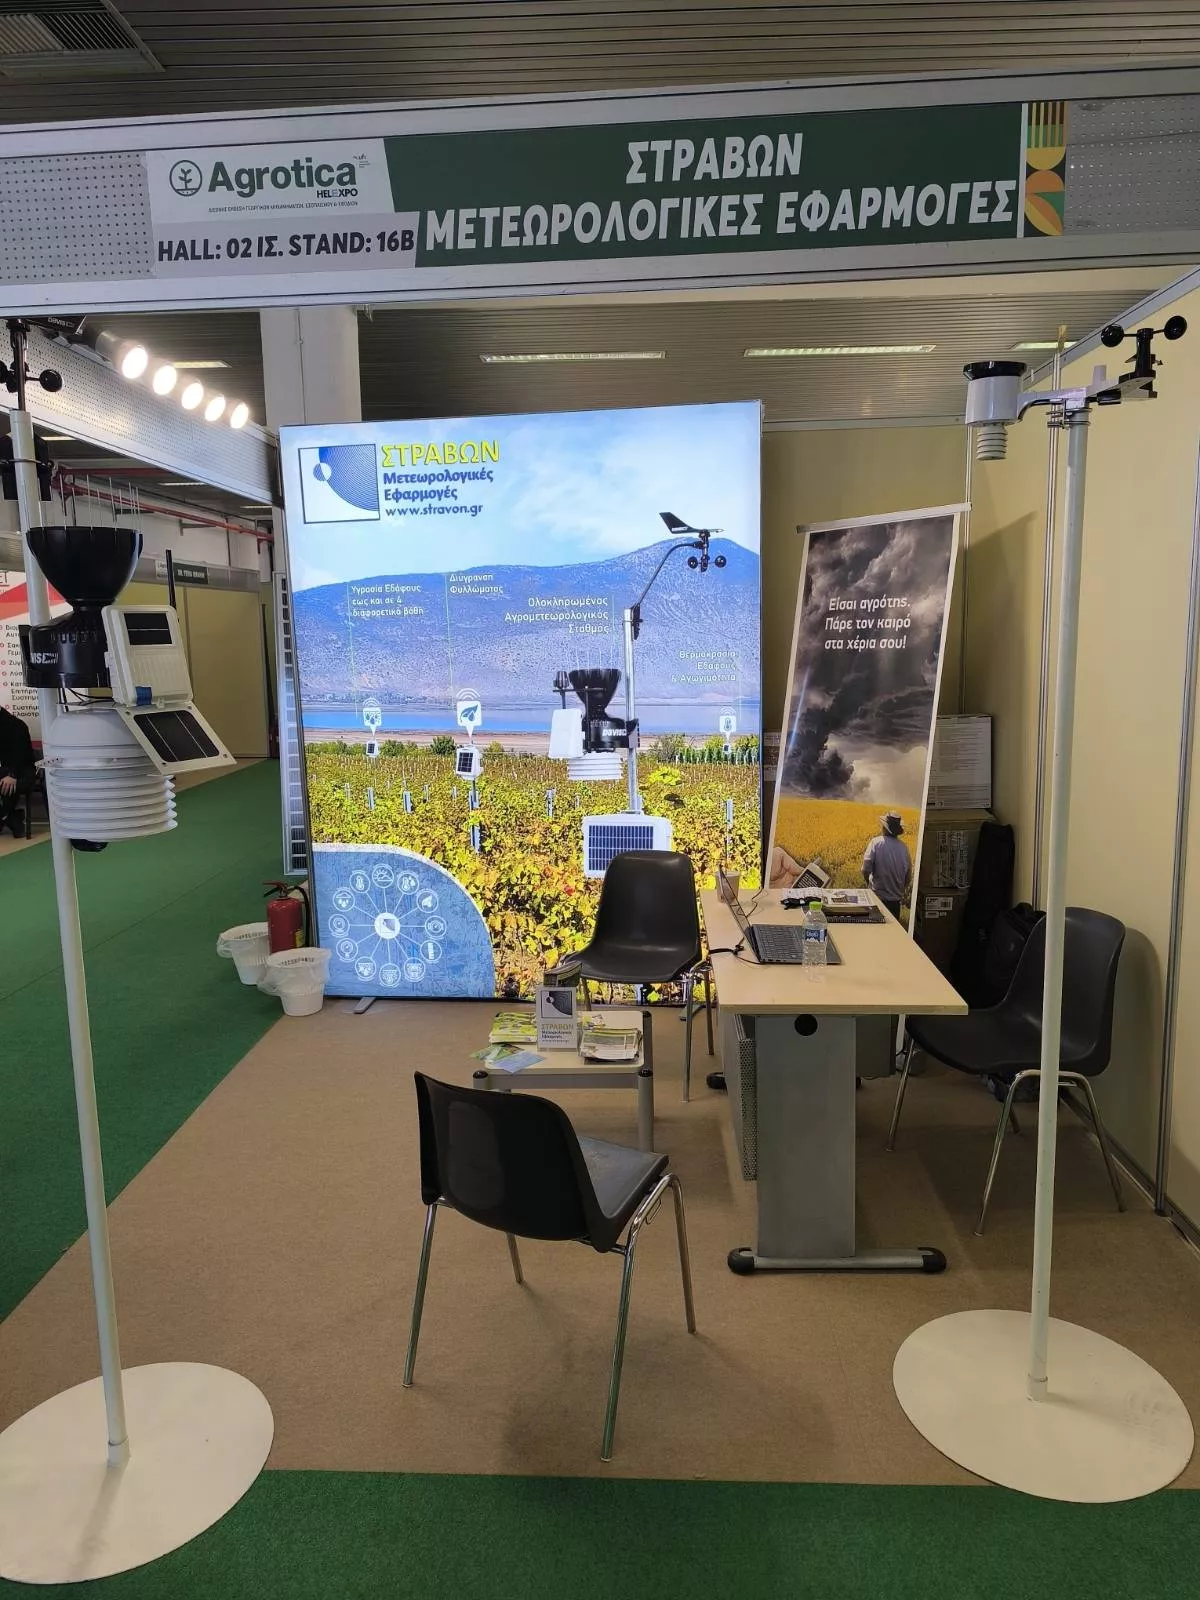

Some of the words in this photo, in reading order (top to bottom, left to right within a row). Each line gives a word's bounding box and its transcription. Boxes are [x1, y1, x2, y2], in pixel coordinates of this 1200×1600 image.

[625, 133, 803, 184] ΣΤΡΑΒΩΝ
[208, 157, 357, 198] Agrotica
[316, 188, 358, 199] HELEXPO
[426, 194, 764, 250] ΜΕΤΕΩΡΟΛΟΓΙΚΕΣ
[776, 180, 1017, 234] ΕΦΑΡΜΟΓΕΣ
[158, 239, 221, 262] HALL:
[227, 237, 252, 259] 02
[289, 232, 372, 257] STAND:
[376, 230, 415, 252] 16B
[381, 440, 499, 468] ΣΤΡΑΒΩΝ
[383, 467, 494, 485] Μετεωρολογικές
[384, 485, 458, 503] Εφαρμογές
[385, 503, 483, 517] www.stravon.gr
[829, 596, 857, 611] Είσαι
[568, 622, 609, 634] Σταθμός
[825, 616, 853, 633] Πάρε
[856, 618, 874, 630] τον
[877, 613, 911, 631] καιρό
[824, 638, 844, 650] στα
[846, 634, 876, 652] χέρια
[880, 634, 907, 649] σου!
